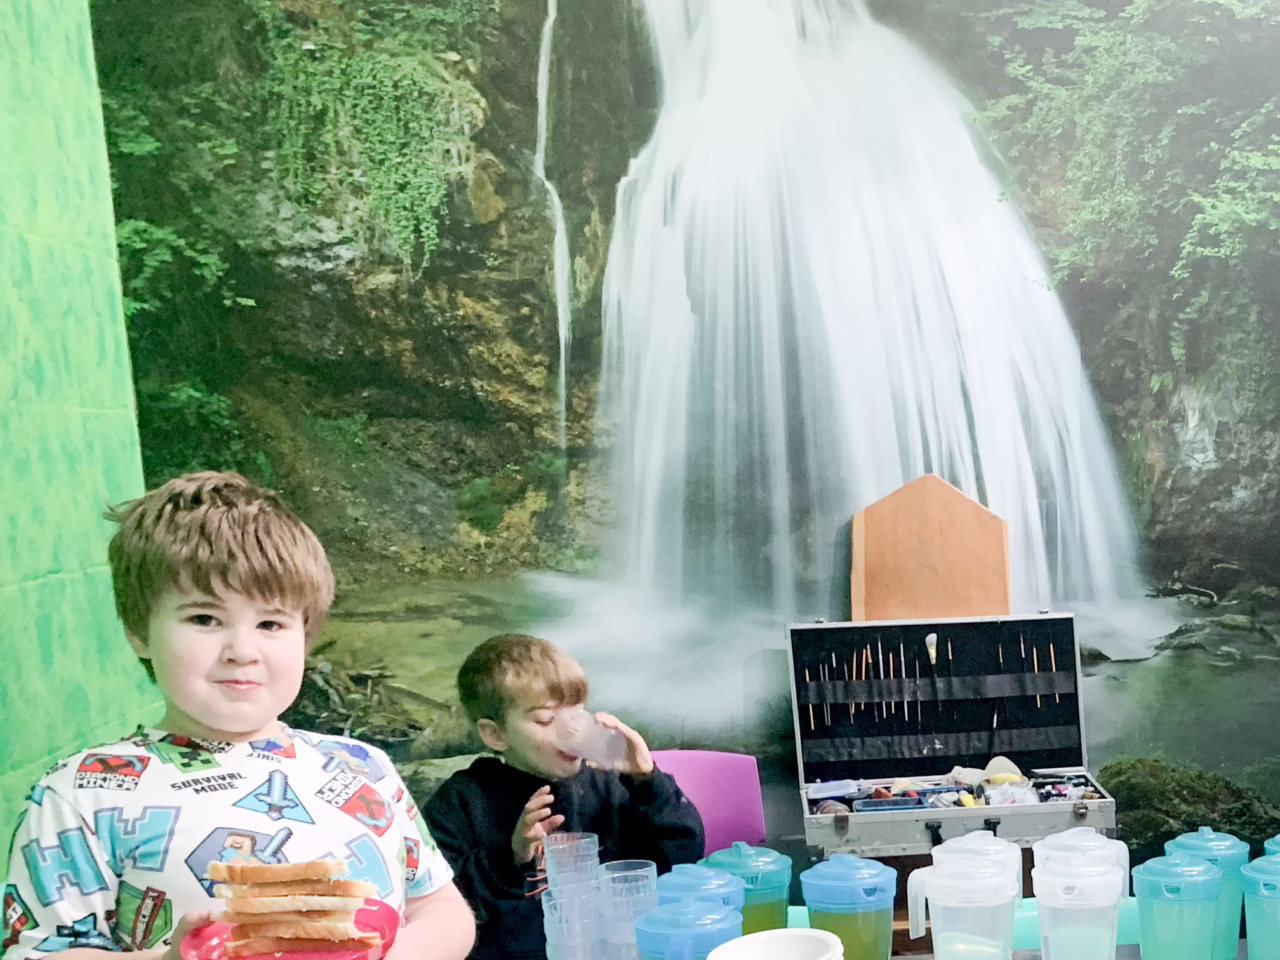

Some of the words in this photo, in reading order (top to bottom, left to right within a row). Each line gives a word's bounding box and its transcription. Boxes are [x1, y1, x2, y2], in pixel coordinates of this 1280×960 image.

[76, 770, 140, 784] DIAMOND
[170, 772, 247, 792] SURVIVAL
[74, 778, 138, 791] MINER
[193, 781, 239, 795] MODE
